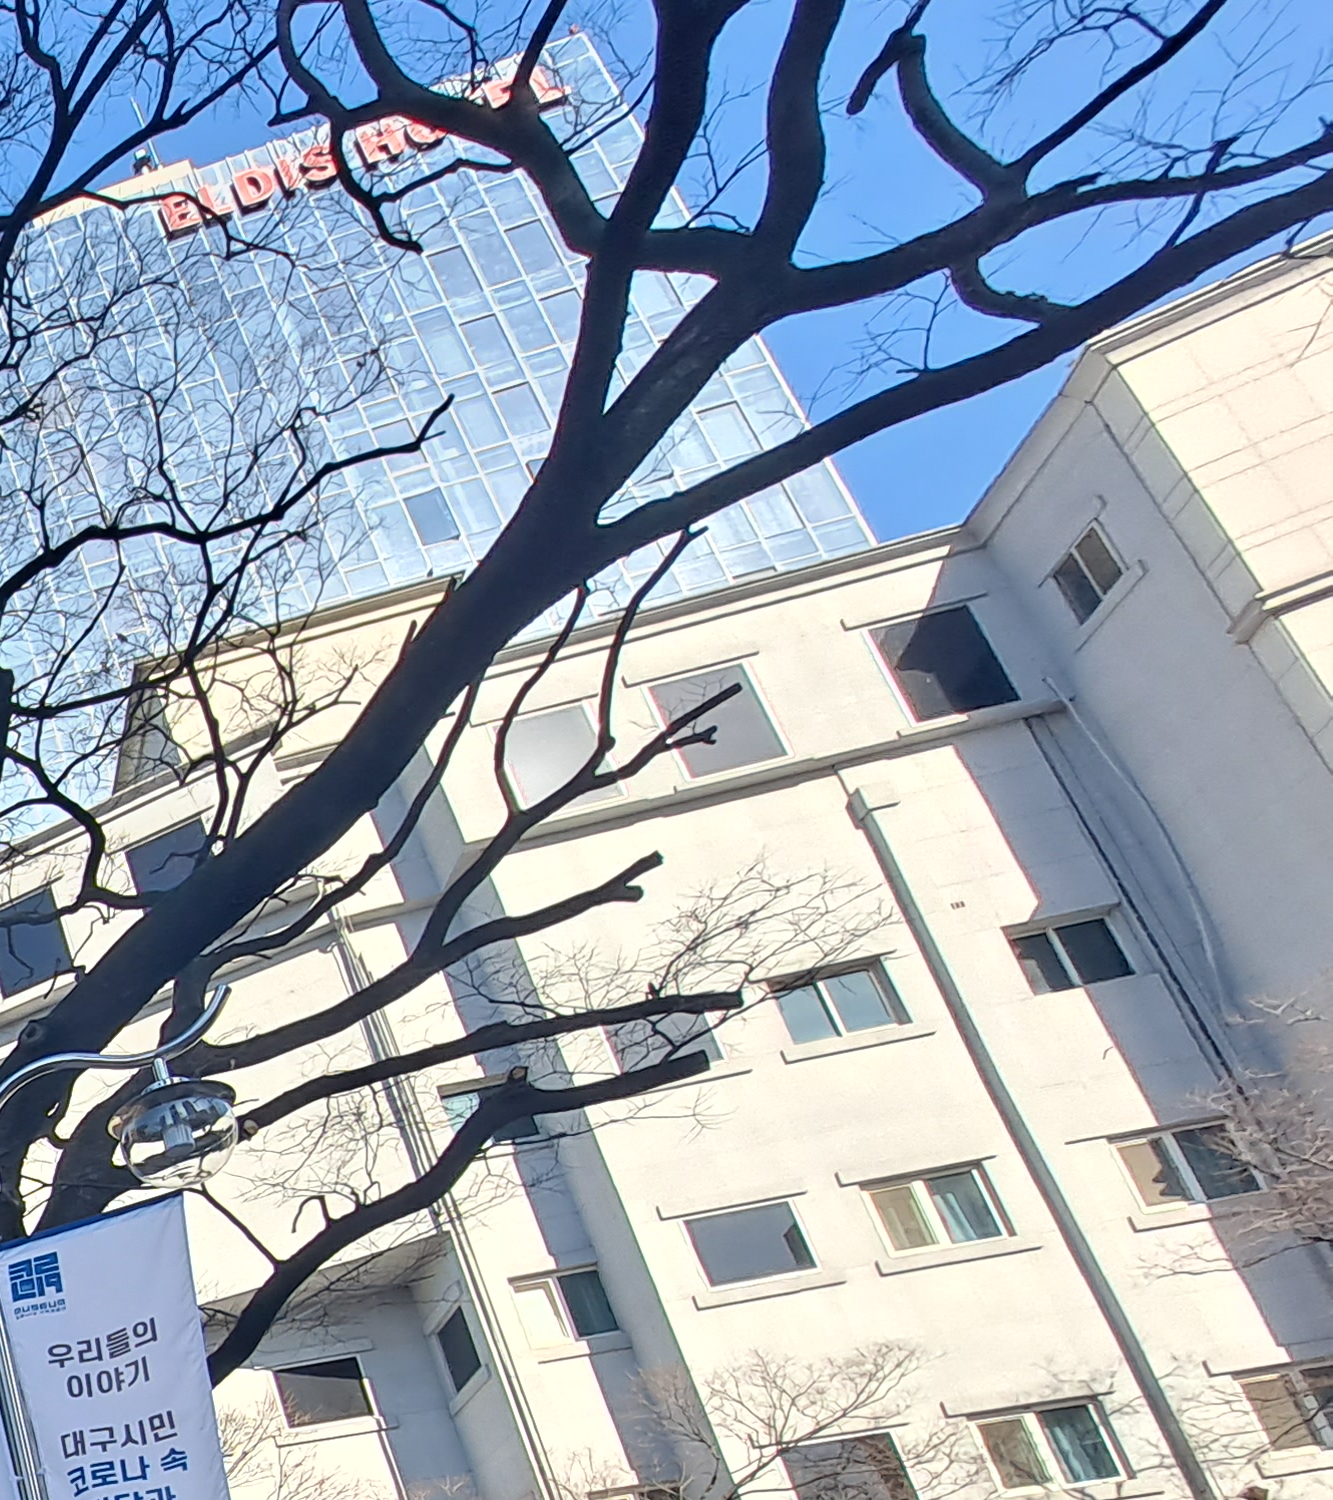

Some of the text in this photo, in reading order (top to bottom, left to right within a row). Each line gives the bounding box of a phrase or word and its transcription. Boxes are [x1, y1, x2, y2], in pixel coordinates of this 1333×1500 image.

[47, 1317, 158, 1368] 우리들의
[67, 1355, 150, 1398] 이야기
[60, 1410, 178, 1459] 대구시민
[67, 1447, 188, 1497] 코로나 속
